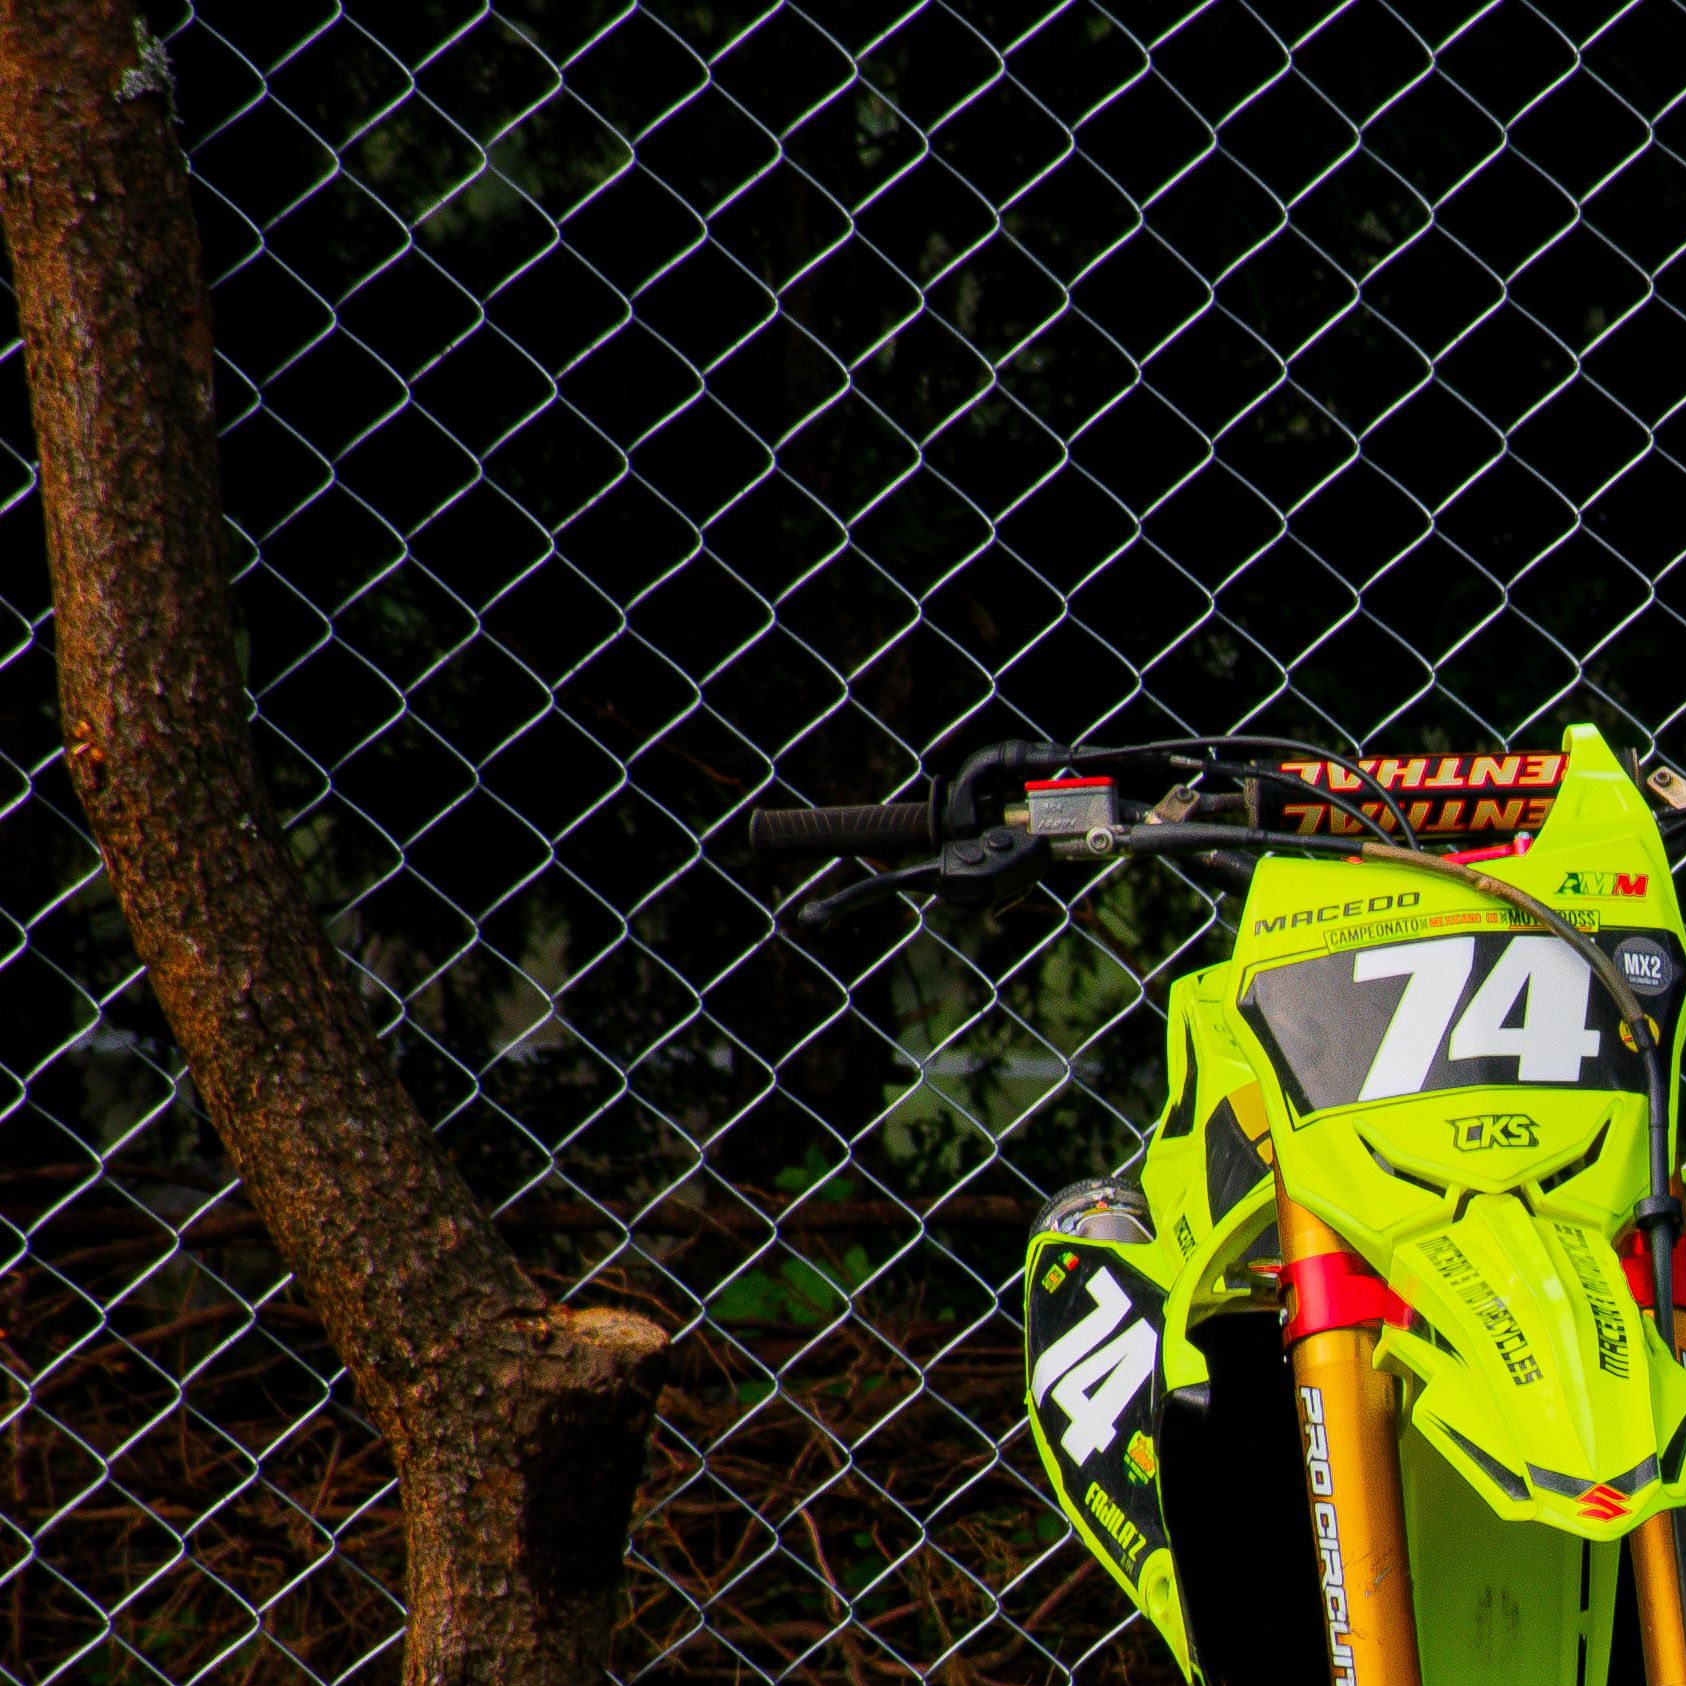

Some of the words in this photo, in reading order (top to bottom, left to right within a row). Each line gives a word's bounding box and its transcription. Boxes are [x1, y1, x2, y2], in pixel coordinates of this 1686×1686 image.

[1281, 754, 1567, 792] ENTHAL
[1254, 892, 1420, 936] MACEDO
[1330, 917, 1418, 946] CAMPEONATO
[1508, 910, 1596, 927] MOROSS
[1623, 952, 1662, 979] MX2
[1353, 936, 1601, 1101] 74
[1031, 1266, 1158, 1467] 74
[1300, 1386, 1332, 1497] PRO
